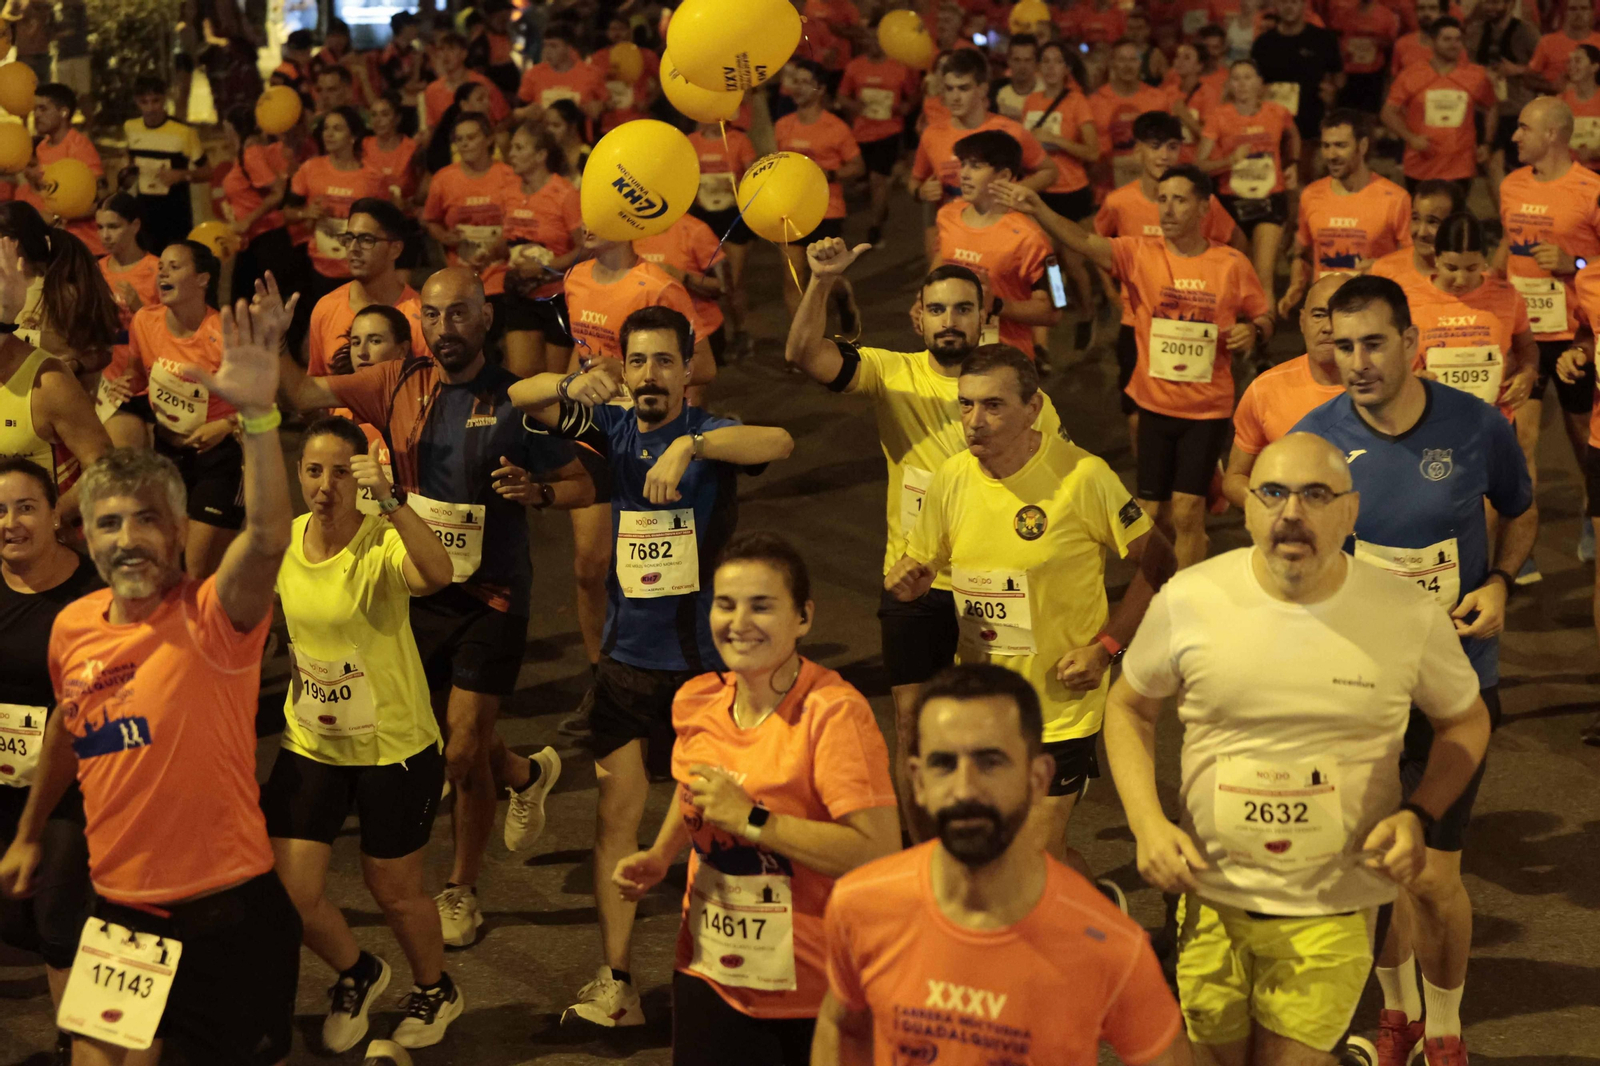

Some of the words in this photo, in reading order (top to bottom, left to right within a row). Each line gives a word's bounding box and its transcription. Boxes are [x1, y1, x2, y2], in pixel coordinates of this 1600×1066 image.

[616, 163, 649, 196] NOCTURNA
[617, 210, 646, 231] SEVILLA
[1174, 279, 1208, 291] XXXV
[581, 310, 608, 326] XXXV
[1161, 341, 1204, 357] 20010
[1442, 370, 1490, 384] 15093
[156, 389, 196, 414] 22615
[628, 541, 673, 561] 7682
[965, 599, 1007, 620] 2603
[303, 679, 352, 704] 19940
[1244, 800, 1310, 825] 2632
[702, 908, 768, 941] 14617
[93, 963, 155, 999] 17143
[925, 978, 1008, 1020] XXXV
